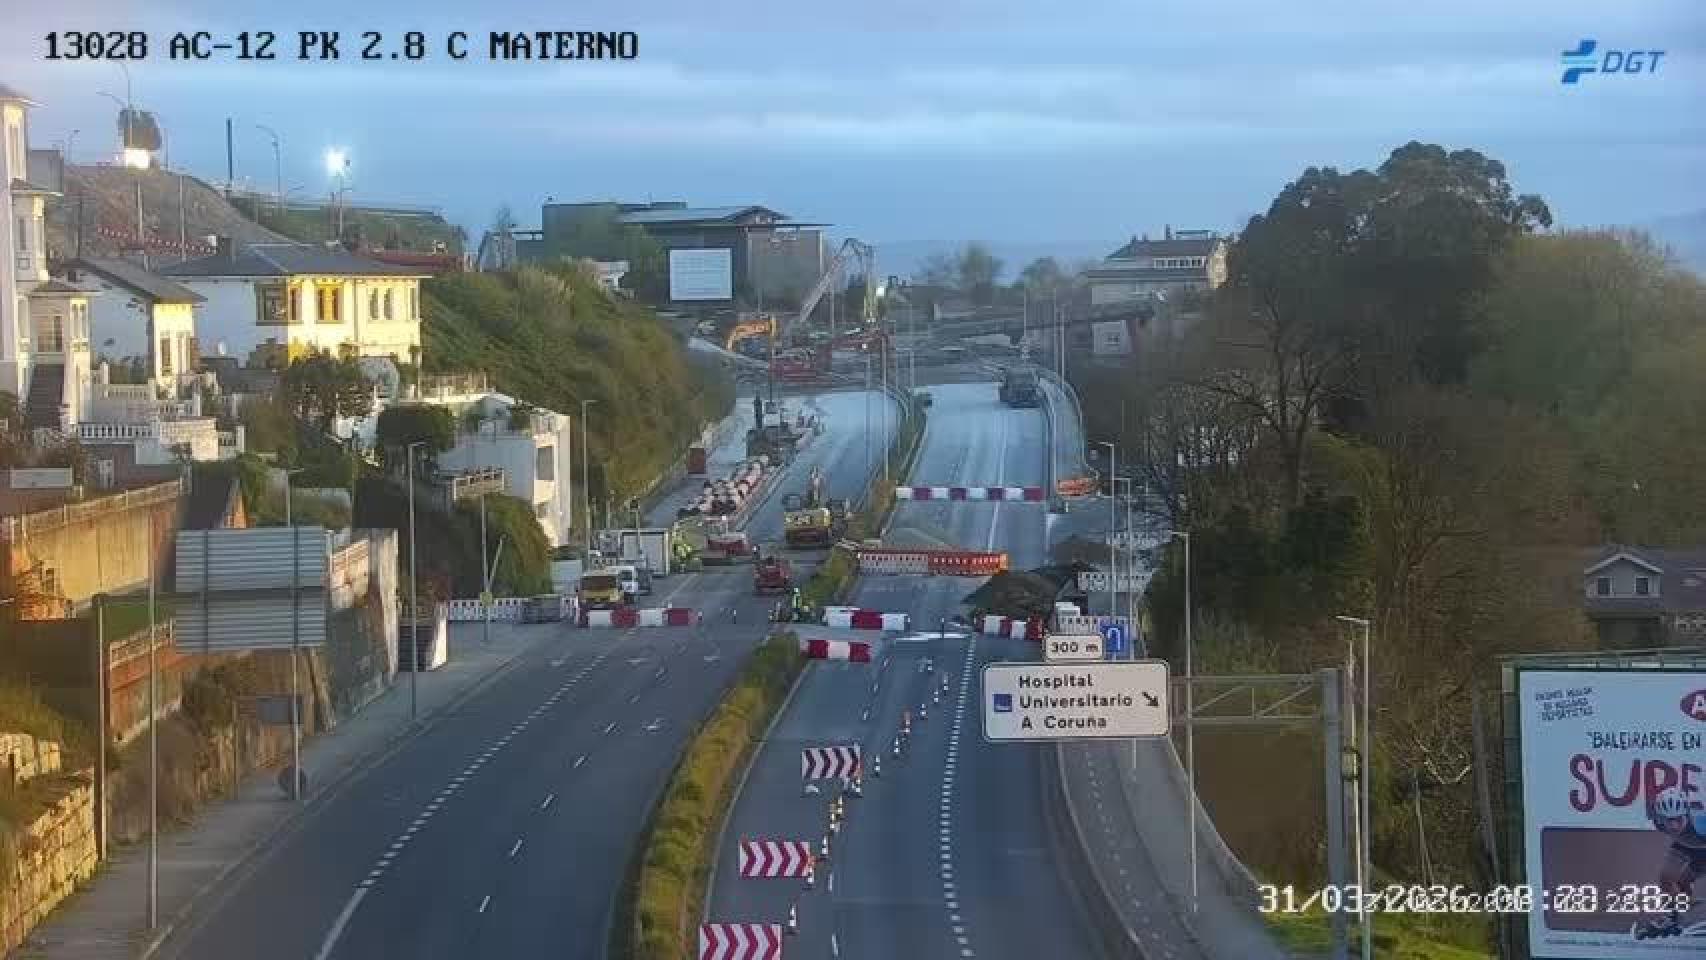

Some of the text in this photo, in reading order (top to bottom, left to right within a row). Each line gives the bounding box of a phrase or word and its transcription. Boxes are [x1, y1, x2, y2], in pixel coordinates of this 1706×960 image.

[1051, 641, 1099, 653] 300 m
[1018, 673, 1095, 690] Hospital
[1018, 693, 1133, 709] Universitario
[1021, 715, 1033, 730] A
[1681, 731, 1701, 750] EN
